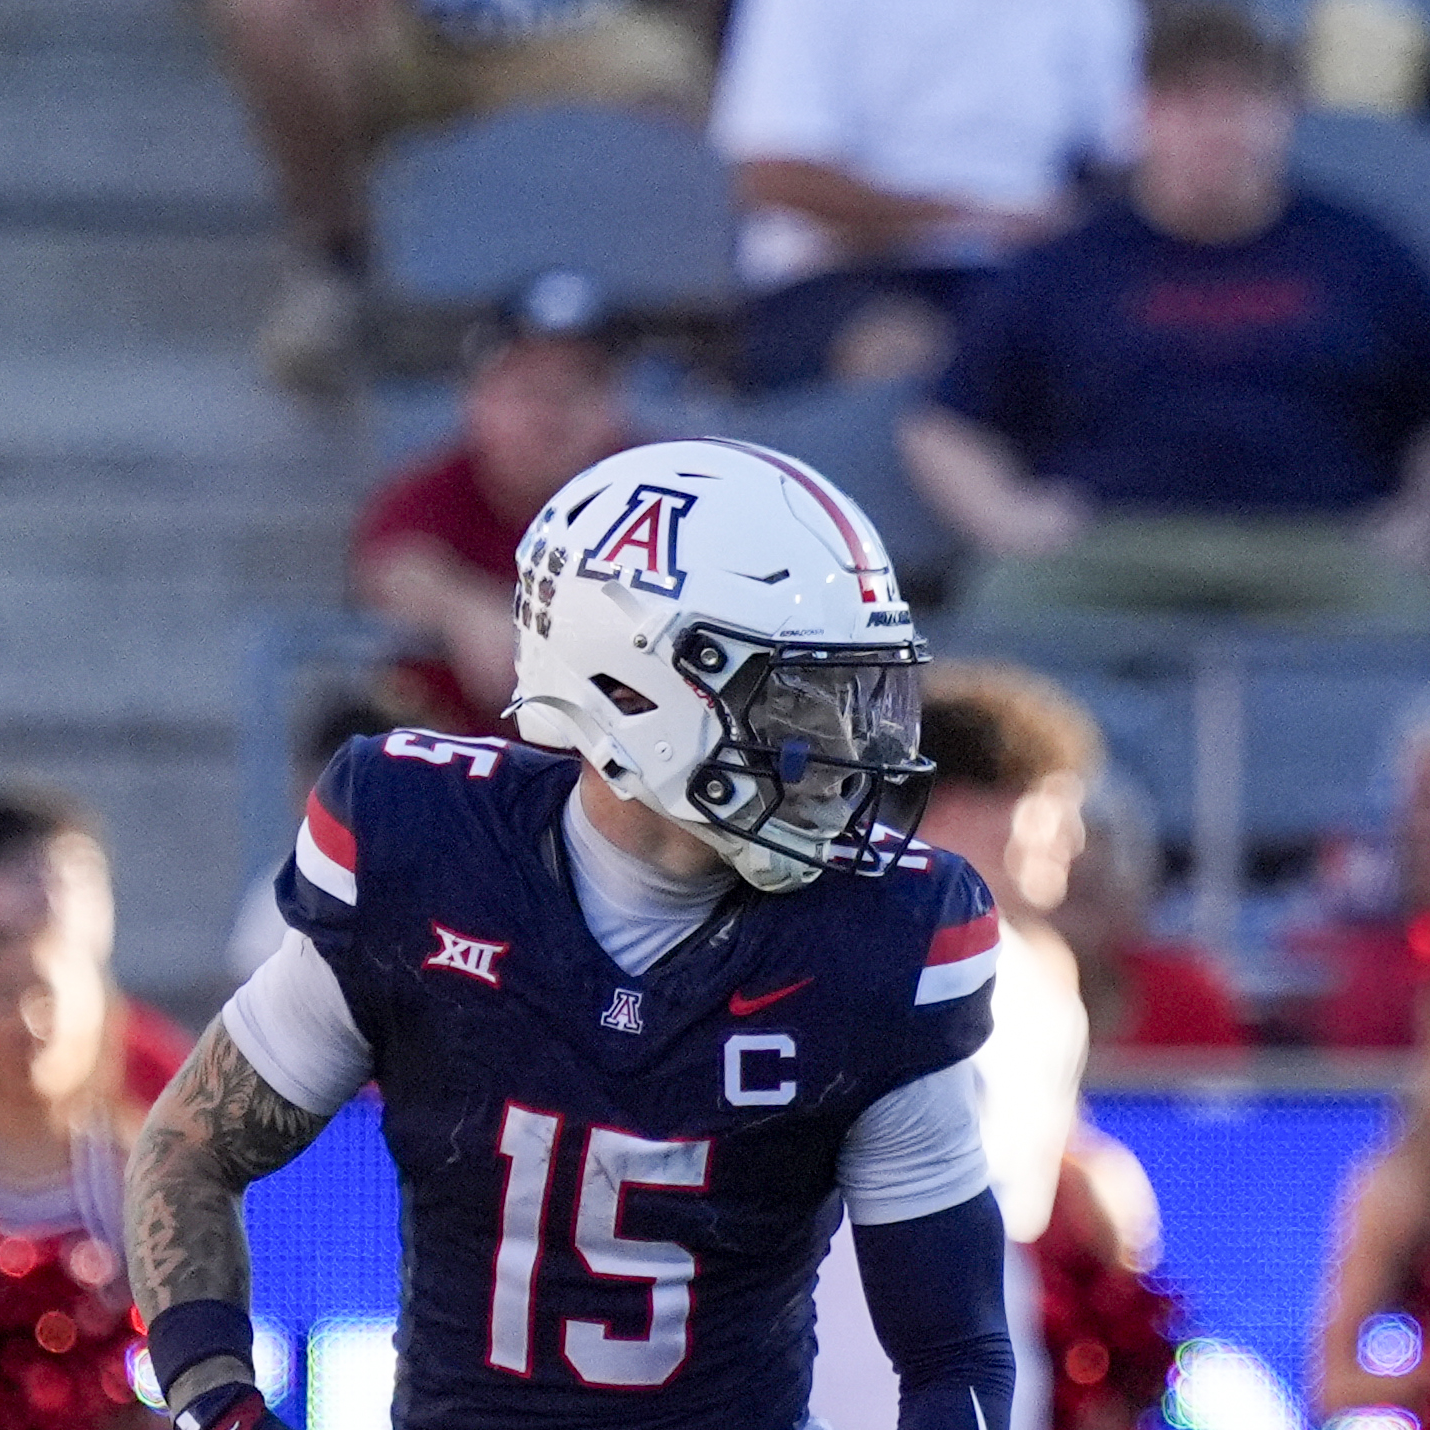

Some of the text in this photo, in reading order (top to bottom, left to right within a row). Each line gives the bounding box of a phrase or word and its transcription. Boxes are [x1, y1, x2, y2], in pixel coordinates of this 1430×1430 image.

[576, 484, 699, 600] A
[425, 922, 507, 986] XII
[601, 988, 642, 1034] A
[724, 1034, 796, 1106] C
[486, 1100, 716, 1391] 15
